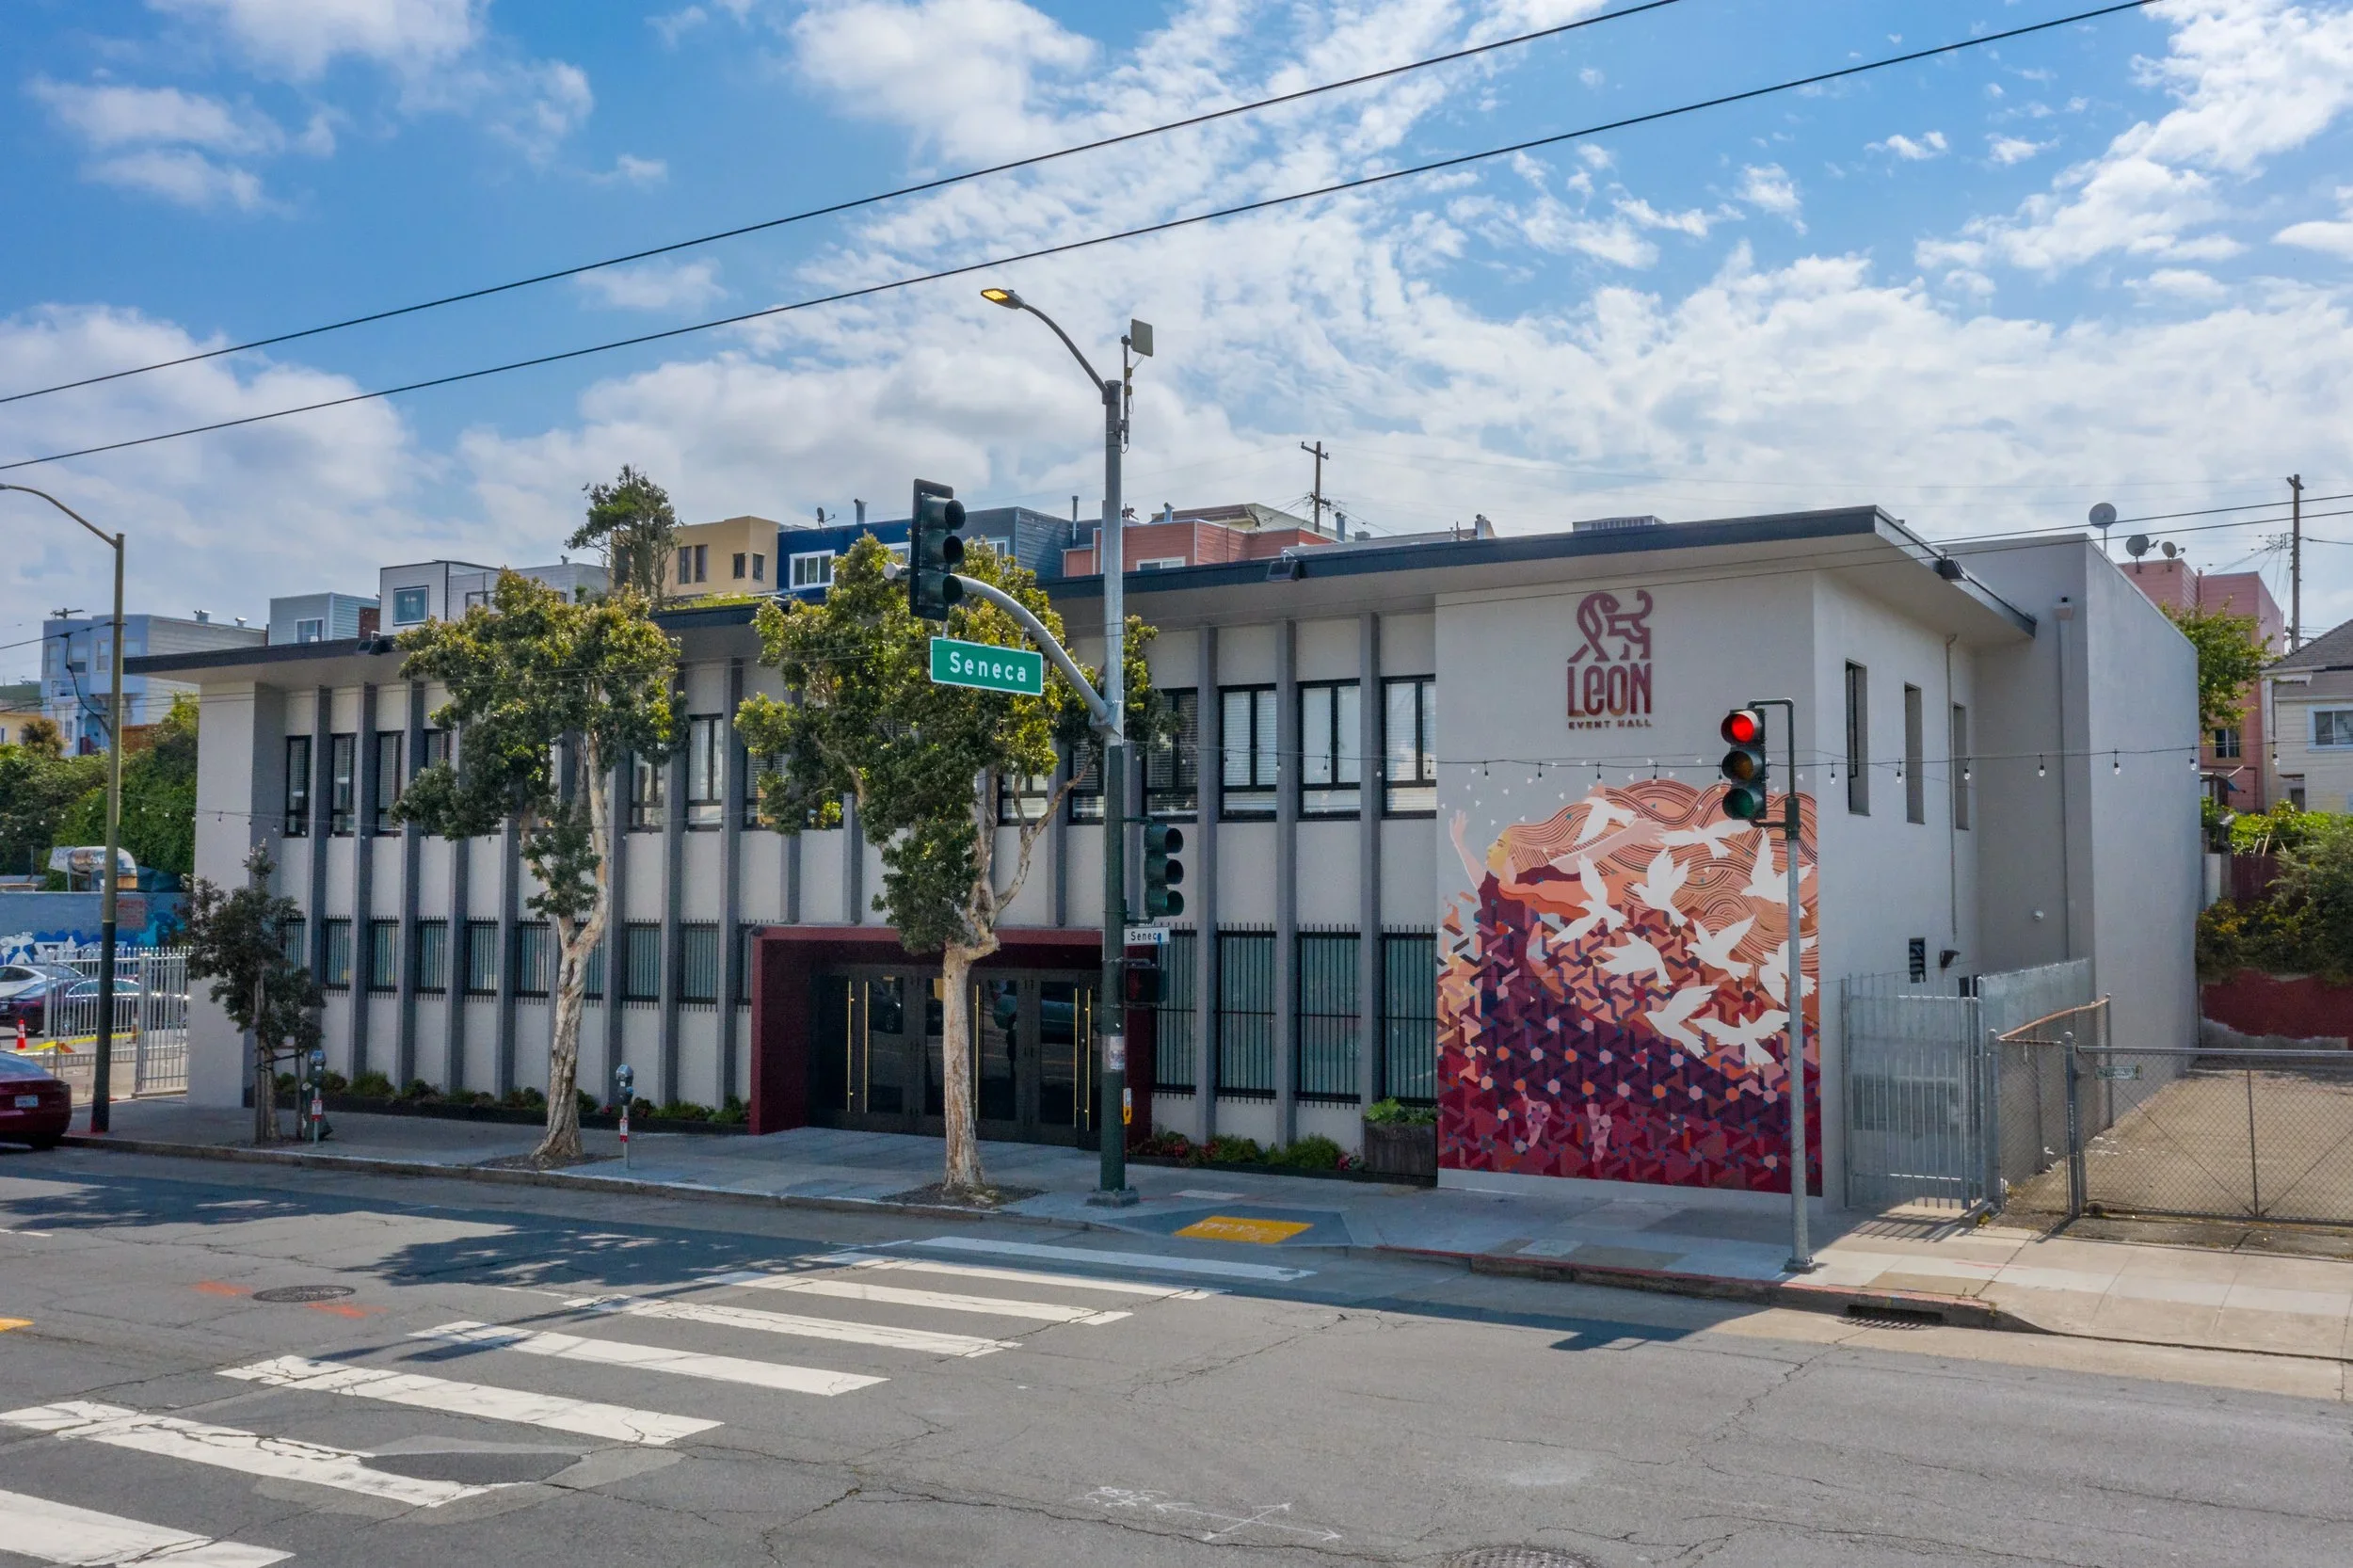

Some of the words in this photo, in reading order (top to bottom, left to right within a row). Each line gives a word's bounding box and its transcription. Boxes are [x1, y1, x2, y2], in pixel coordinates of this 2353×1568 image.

[950, 651, 1026, 682] Seneca
[1568, 720, 1610, 730] EVENT
[1617, 718, 1652, 728] HALL
